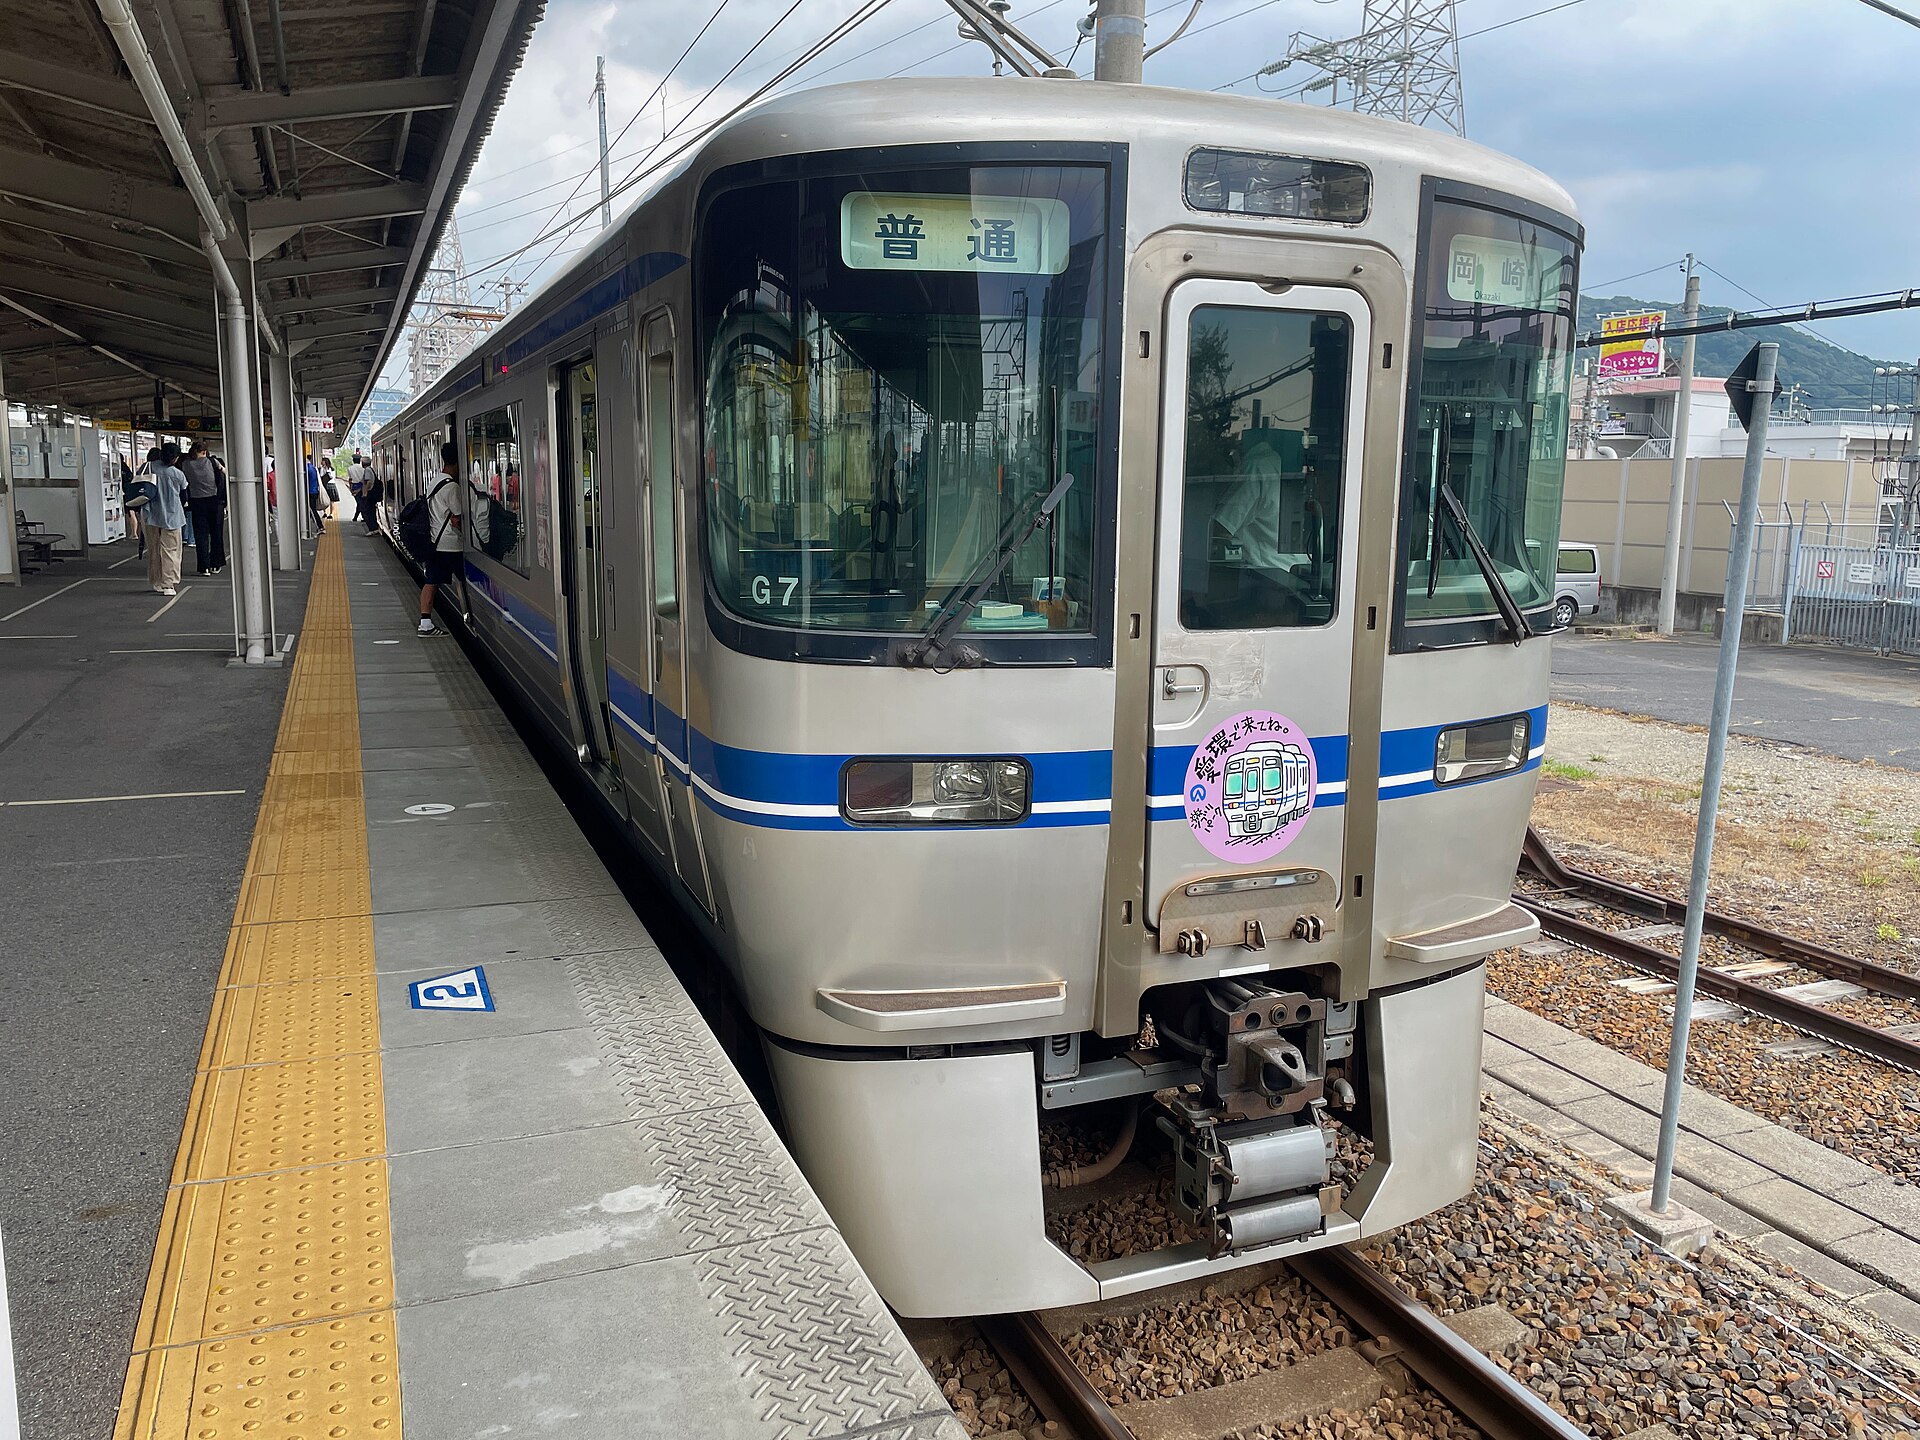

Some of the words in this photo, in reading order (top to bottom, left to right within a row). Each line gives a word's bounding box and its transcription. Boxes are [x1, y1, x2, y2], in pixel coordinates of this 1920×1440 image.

[874, 213, 1018, 263] 普通
[1452, 250, 1526, 291] 岡崎
[1474, 290, 1501, 301] Okazaki
[312, 401, 319, 413] 1
[422, 982, 478, 1001] 2
